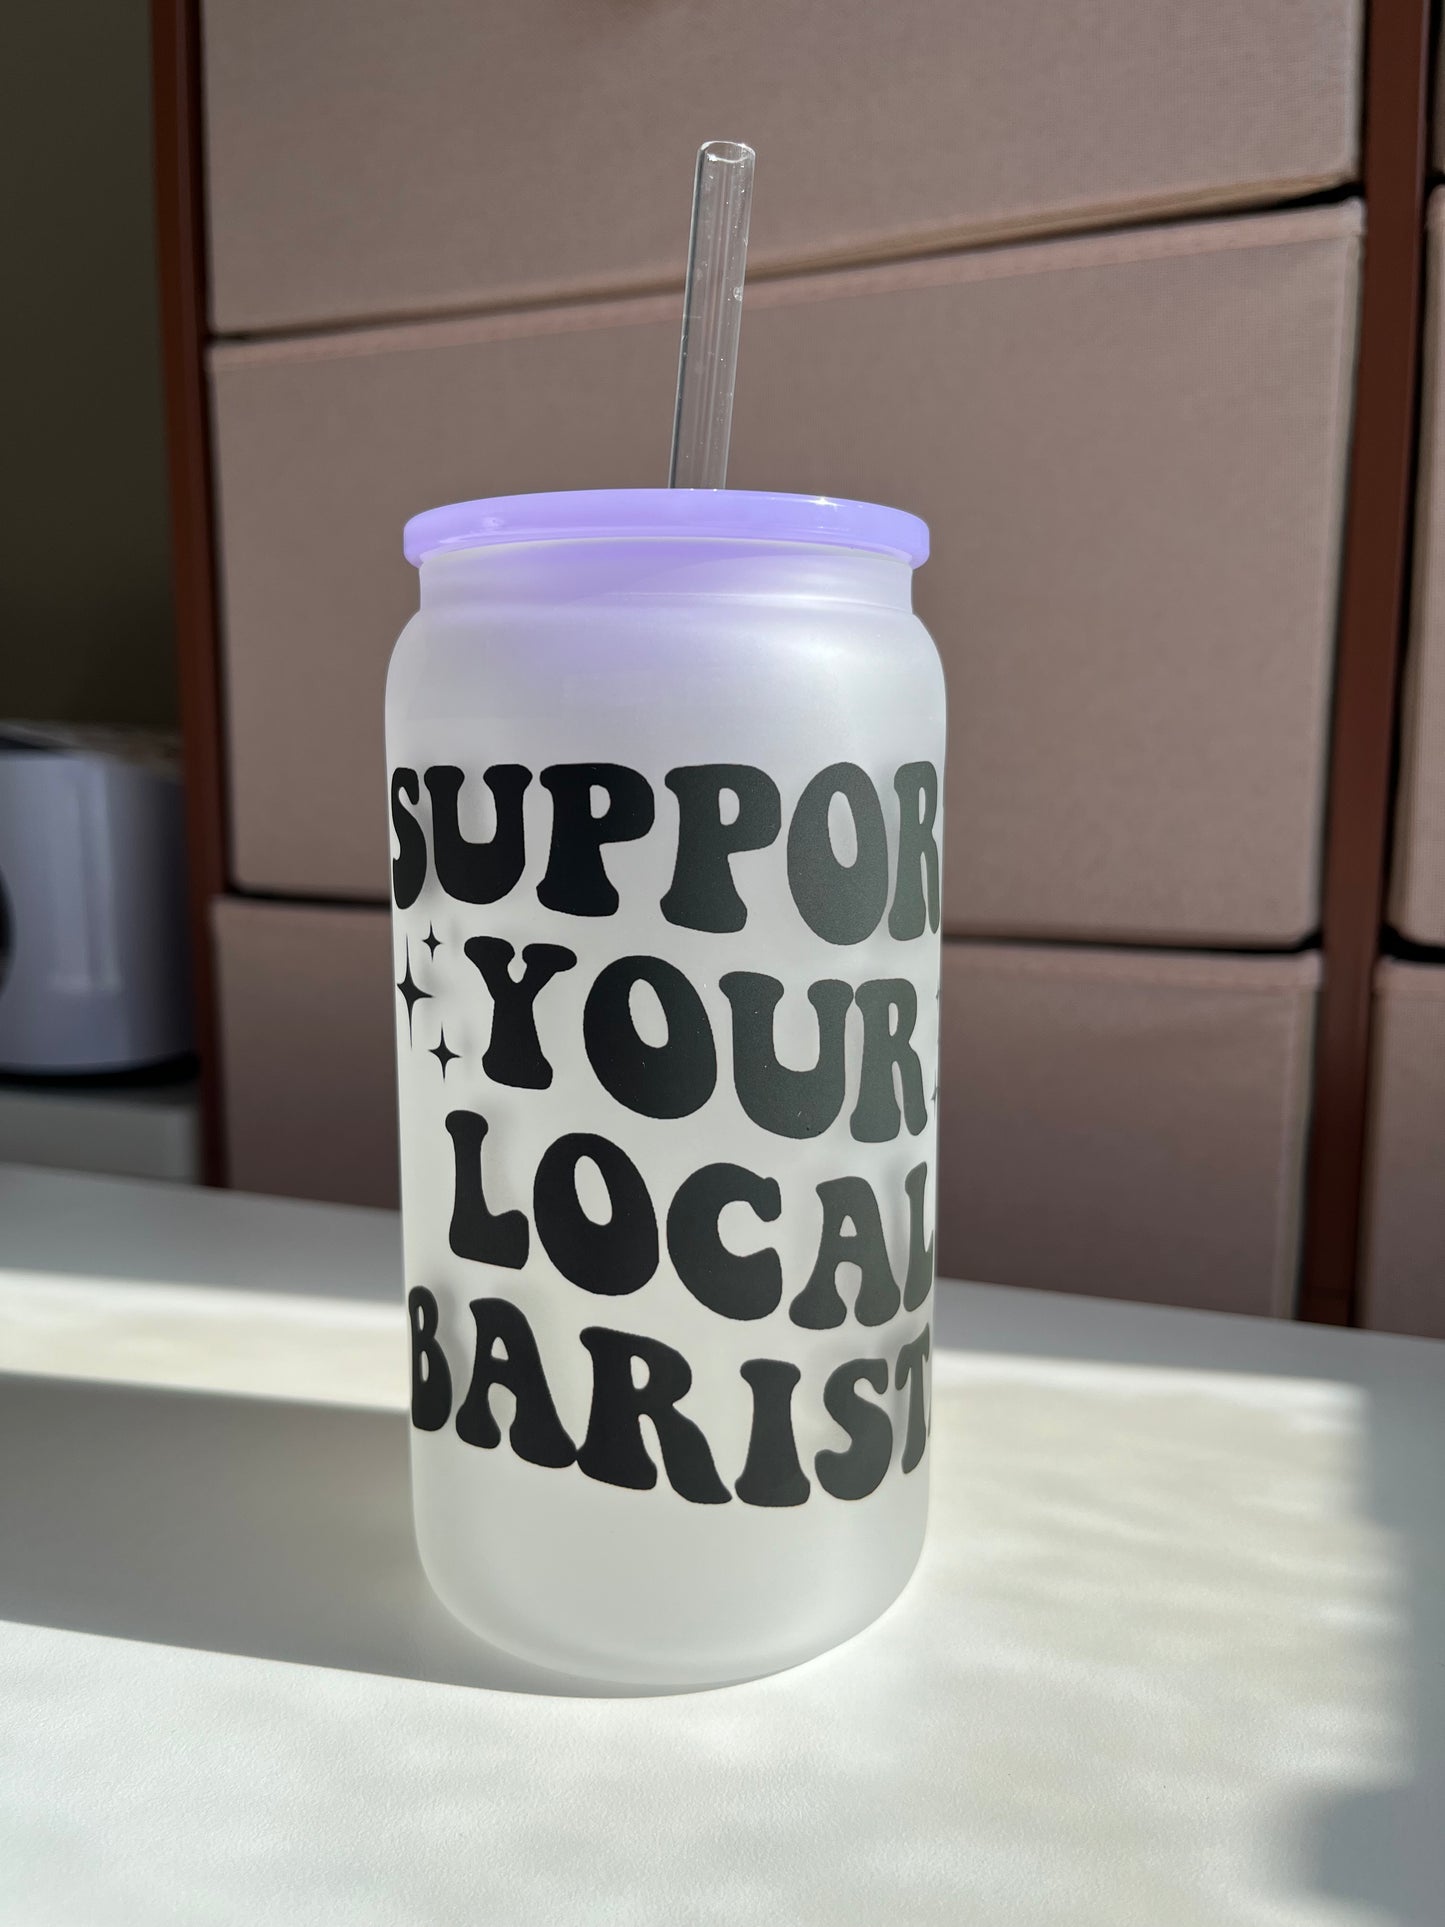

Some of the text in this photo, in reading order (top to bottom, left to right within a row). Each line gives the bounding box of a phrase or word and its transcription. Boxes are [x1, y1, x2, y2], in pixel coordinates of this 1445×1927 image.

[391, 761, 940, 946] SUPPOR
[464, 936, 928, 1142] YOUR
[445, 1110, 934, 1330] LOCAL
[408, 1286, 932, 1507] BARIST
